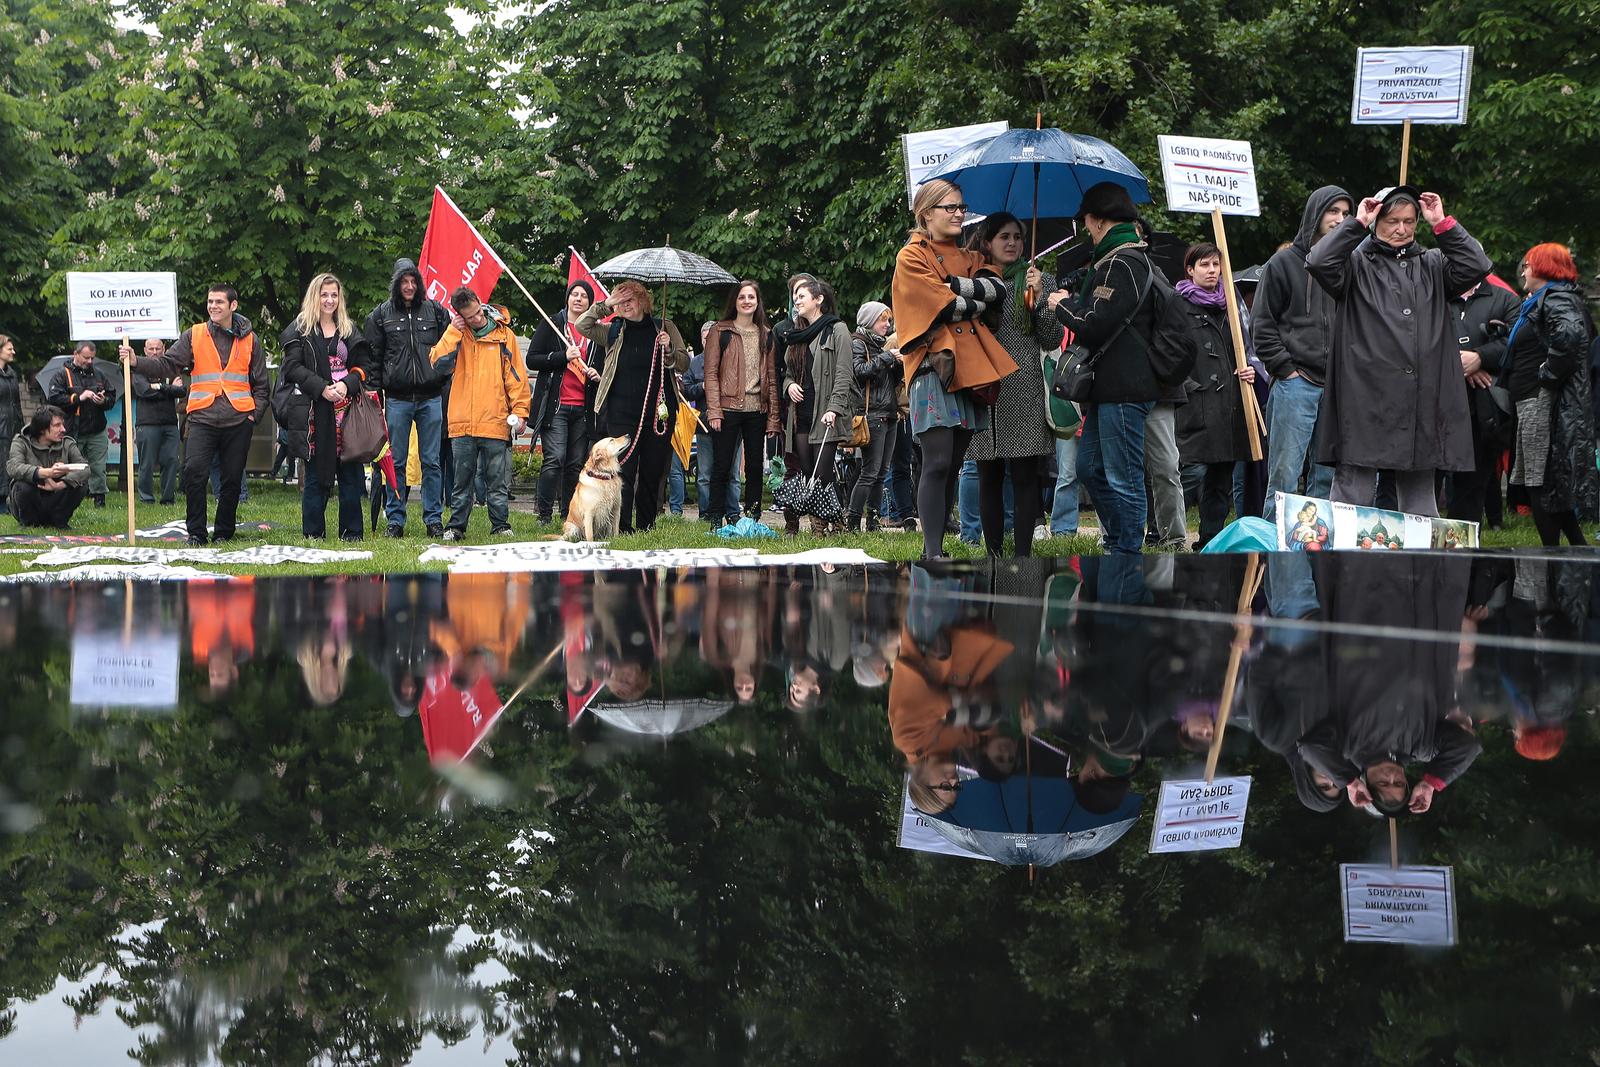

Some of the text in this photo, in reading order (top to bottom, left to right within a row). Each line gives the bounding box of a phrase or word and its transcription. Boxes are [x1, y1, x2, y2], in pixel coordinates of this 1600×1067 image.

[1394, 66, 1428, 74] PROTIV
[1378, 78, 1442, 87] PRIVATIZACIJE
[1380, 91, 1438, 100] ZDRAVSTVA!
[922, 152, 954, 165] USTA
[1171, 146, 1248, 163] LGBTIQ RADNIŠTVO
[1187, 172, 1238, 190] i 1. MAJ je
[1188, 189, 1242, 207] NAŠ PRIDE
[90, 288, 152, 298] KO JE JAMIO
[95, 307, 151, 318] ROBIJAT ĆE
